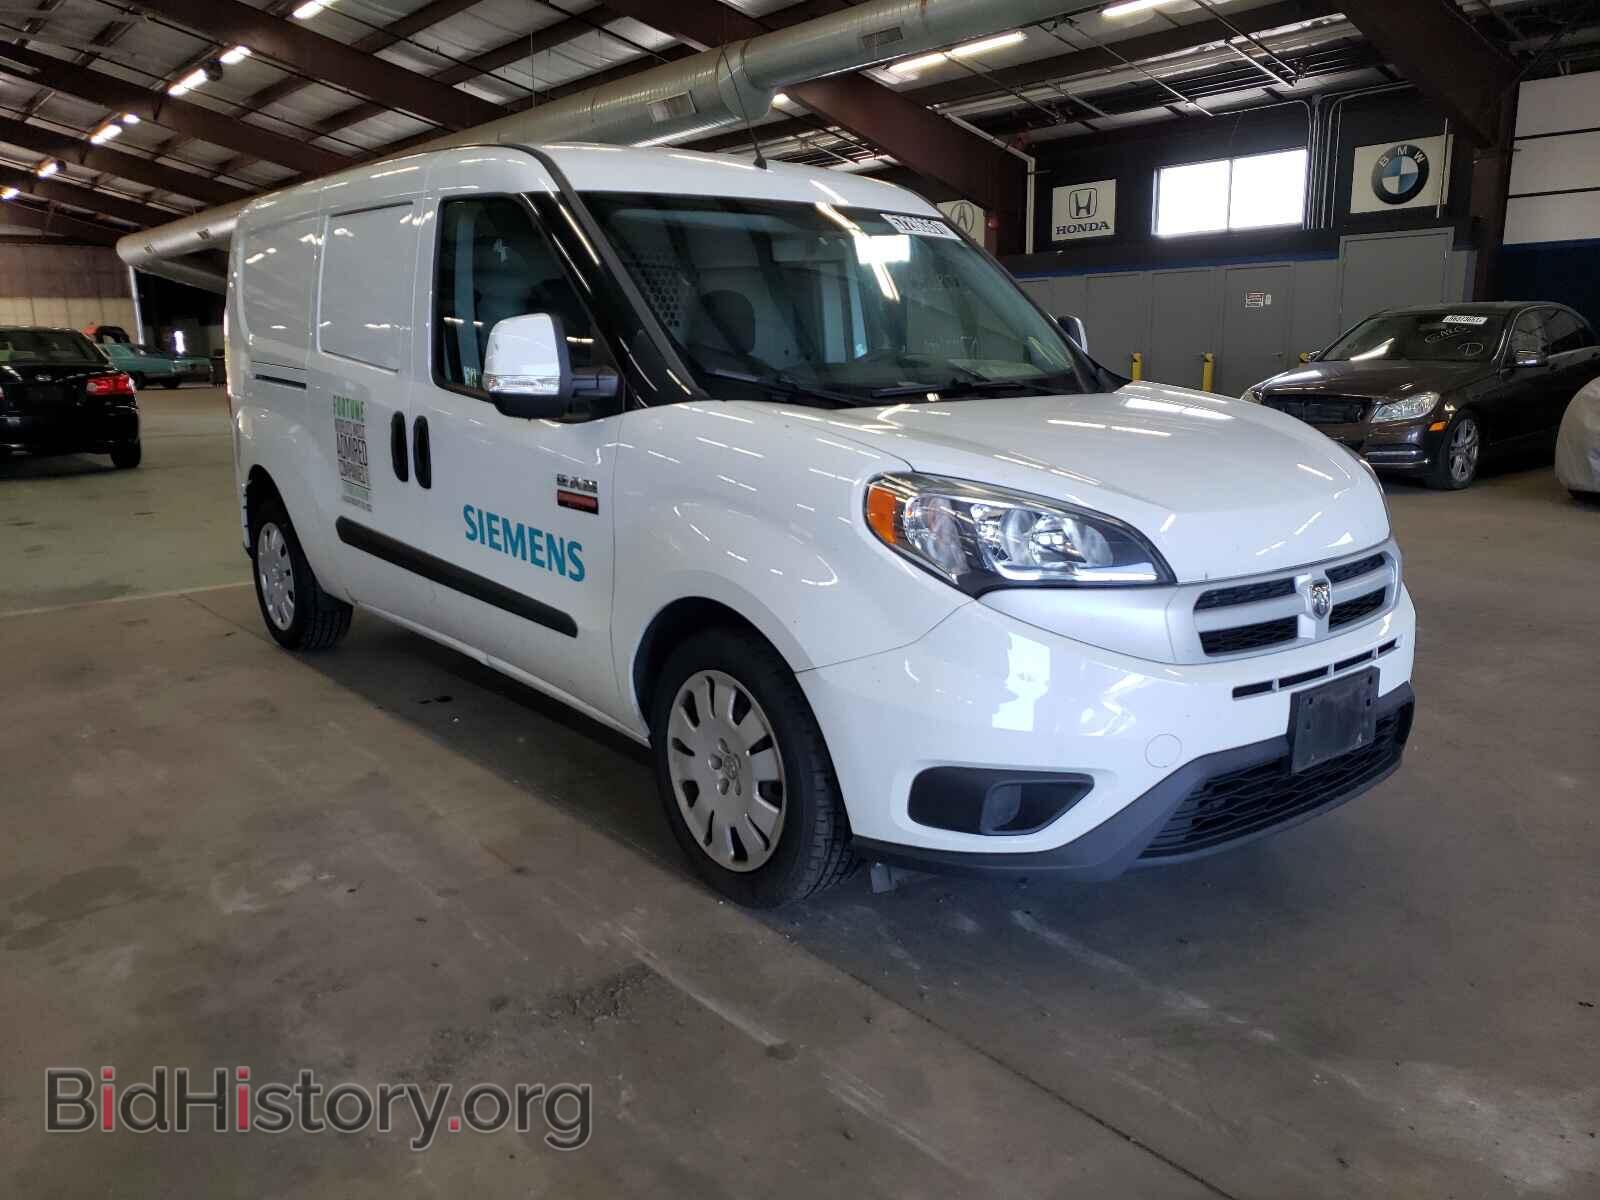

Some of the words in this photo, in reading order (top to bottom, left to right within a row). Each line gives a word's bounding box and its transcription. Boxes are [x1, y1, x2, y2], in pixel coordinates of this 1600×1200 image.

[1379, 145, 1426, 168] BMW
[1056, 221, 1112, 235] HONDA
[463, 504, 585, 582] SIEMENS
